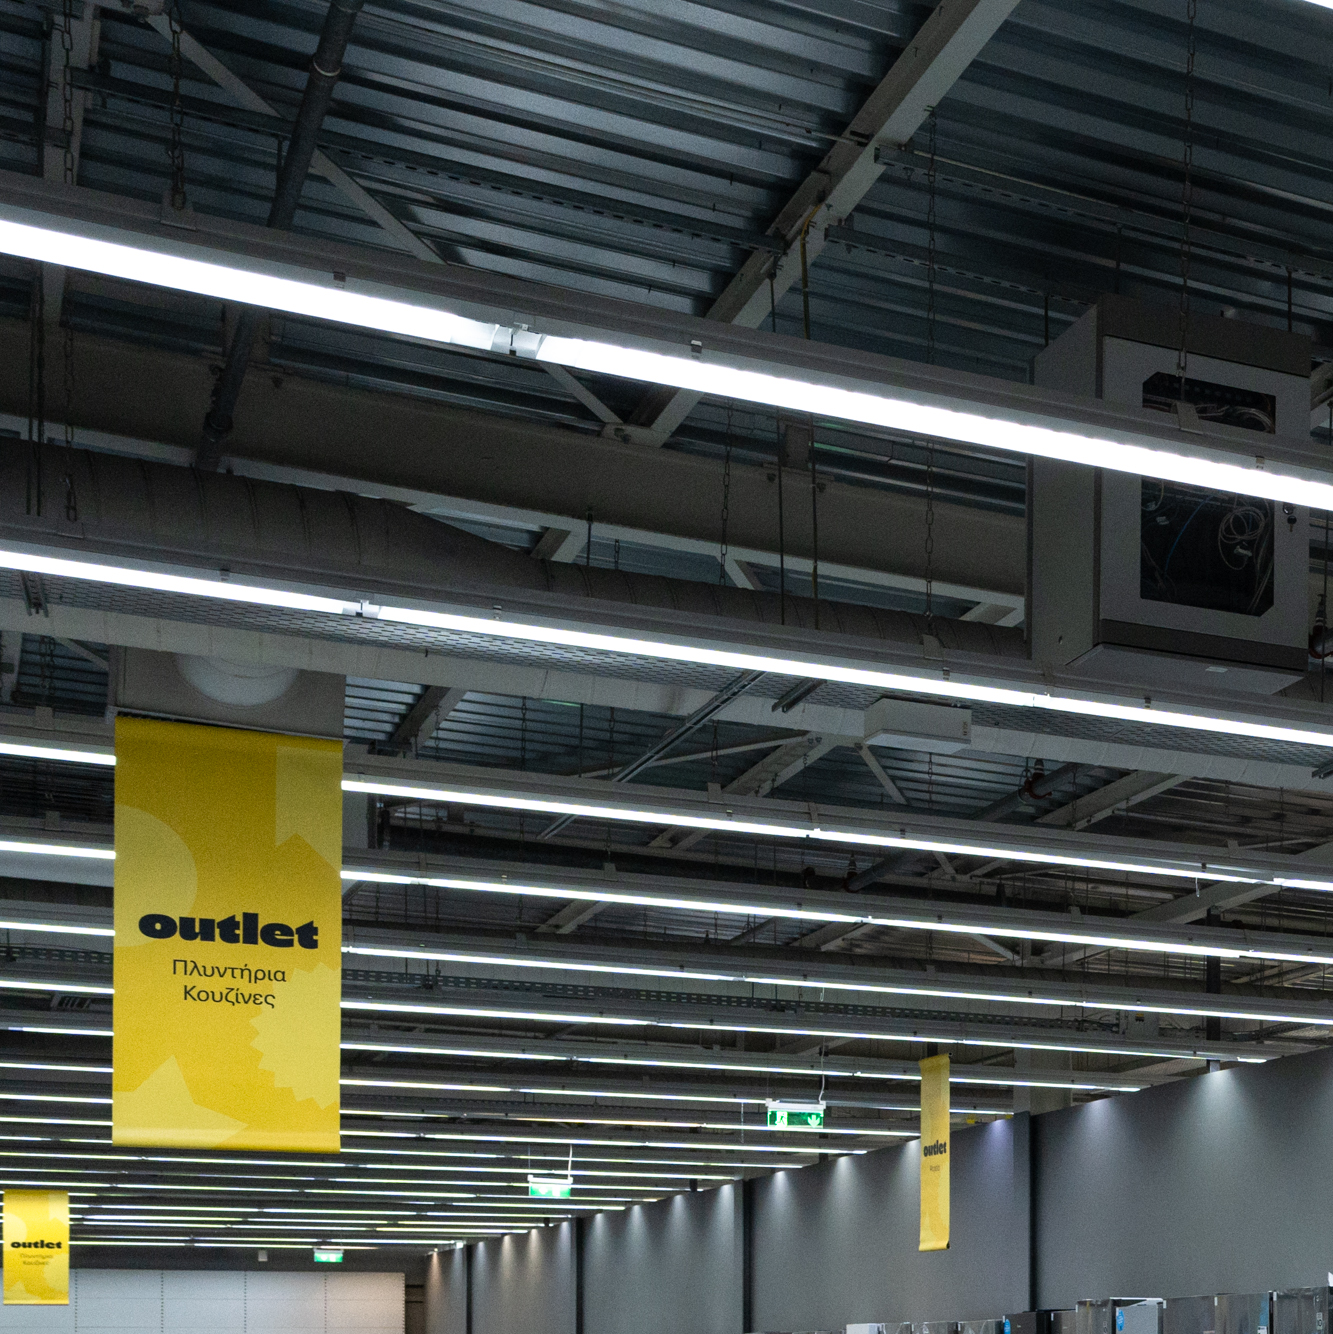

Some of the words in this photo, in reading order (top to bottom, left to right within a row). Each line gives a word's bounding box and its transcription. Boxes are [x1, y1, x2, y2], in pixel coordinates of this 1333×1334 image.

[138, 912, 318, 949] outlet
[173, 959, 287, 984] Πλυντήρια
[184, 985, 276, 1009] Κουζίνες
[923, 1140, 947, 1157] outlet
[10, 1240, 62, 1249] outlet
